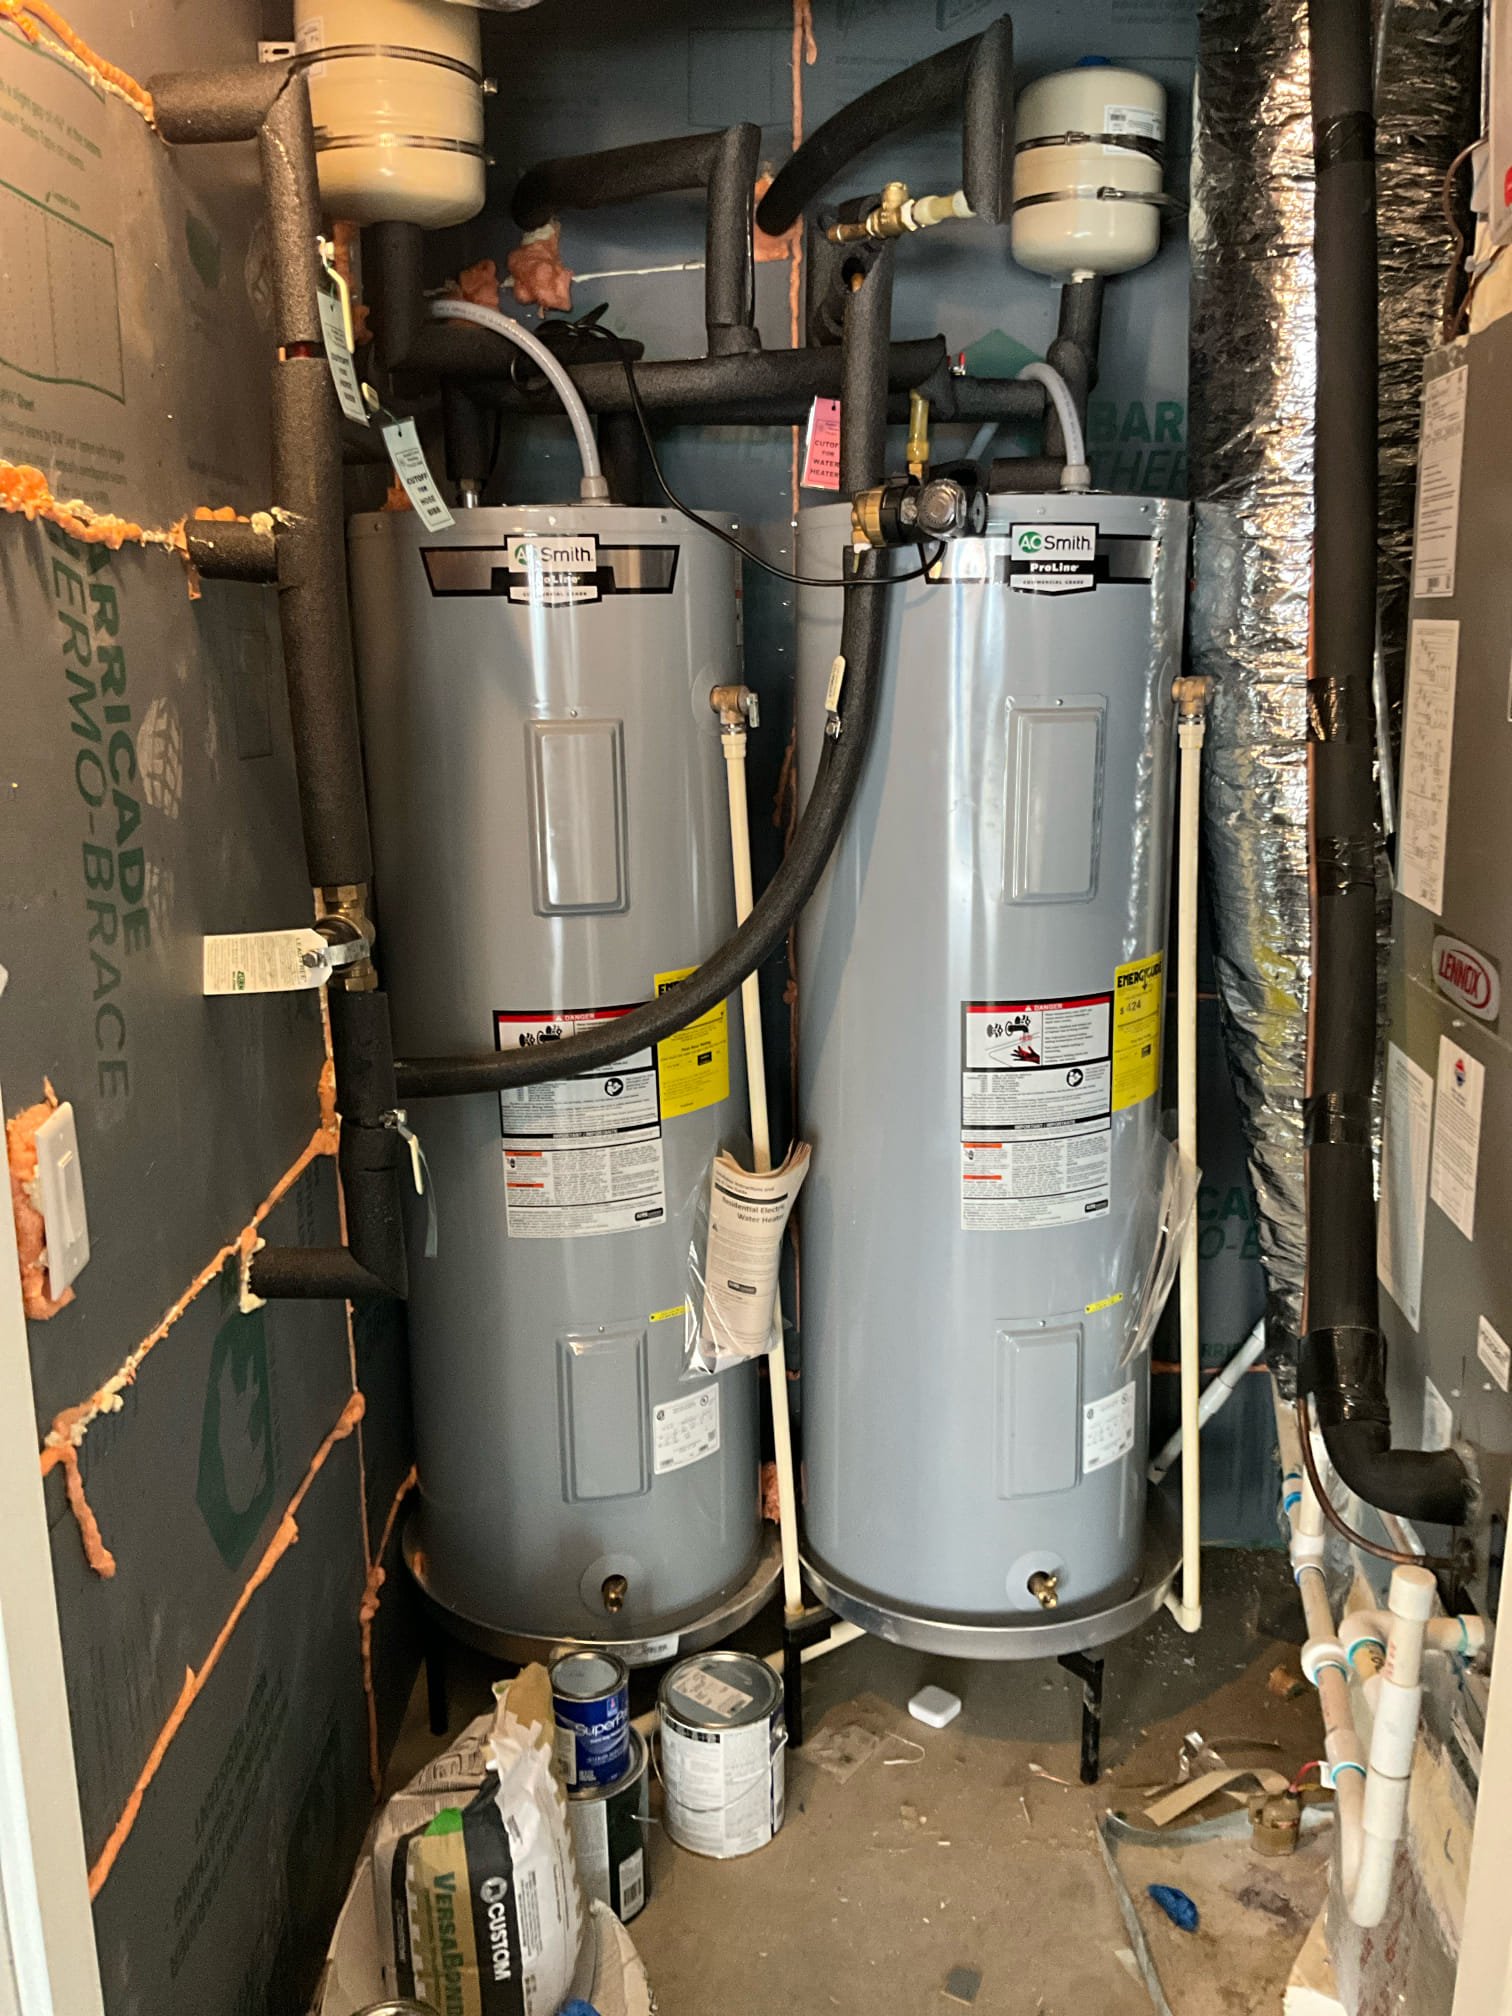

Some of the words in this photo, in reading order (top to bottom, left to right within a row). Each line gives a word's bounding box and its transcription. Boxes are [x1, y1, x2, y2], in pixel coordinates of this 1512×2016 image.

[1019, 532, 1042, 553] AO
[1044, 535, 1090, 551] Smith
[541, 547, 591, 563] Smith
[1030, 562, 1079, 573] ProLine
[1438, 949, 1481, 1000] LENNOX
[564, 1012, 596, 1022] DANGER
[722, 1196, 760, 1214] Residential
[736, 1213, 760, 1224] Water
[761, 1213, 785, 1224] Heater
[487, 1902, 512, 1982] CUSTOM
